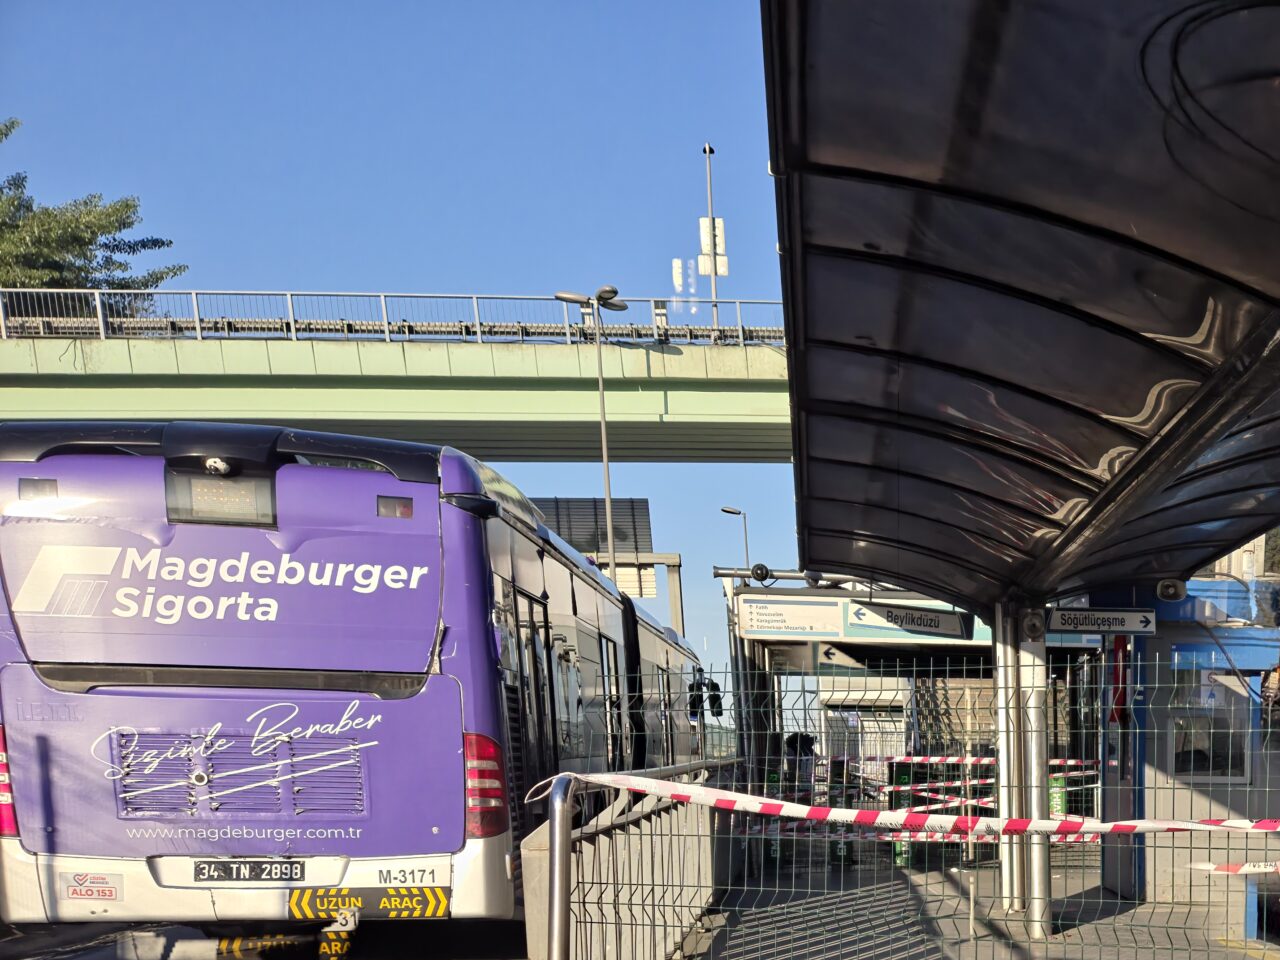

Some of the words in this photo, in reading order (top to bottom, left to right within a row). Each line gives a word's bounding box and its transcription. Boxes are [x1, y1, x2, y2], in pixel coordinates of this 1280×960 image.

[121, 547, 429, 594] Magdeburger
[112, 587, 279, 625] Sigorta
[886, 610, 940, 630] Beylikdüzü
[1060, 613, 1126, 629] Söğütlüçeşme
[246, 700, 383, 757] Beraber
[126, 824, 363, 844] www.magdeburger.com.tr
[199, 865, 219, 880] 34
[230, 865, 250, 879] TN
[260, 864, 302, 880] 2898
[378, 869, 437, 885] M-3171
[71, 888, 94, 897] ALO
[96, 889, 113, 898] 153
[316, 896, 362, 910] UZUN
[379, 896, 423, 912] ARAÇ
